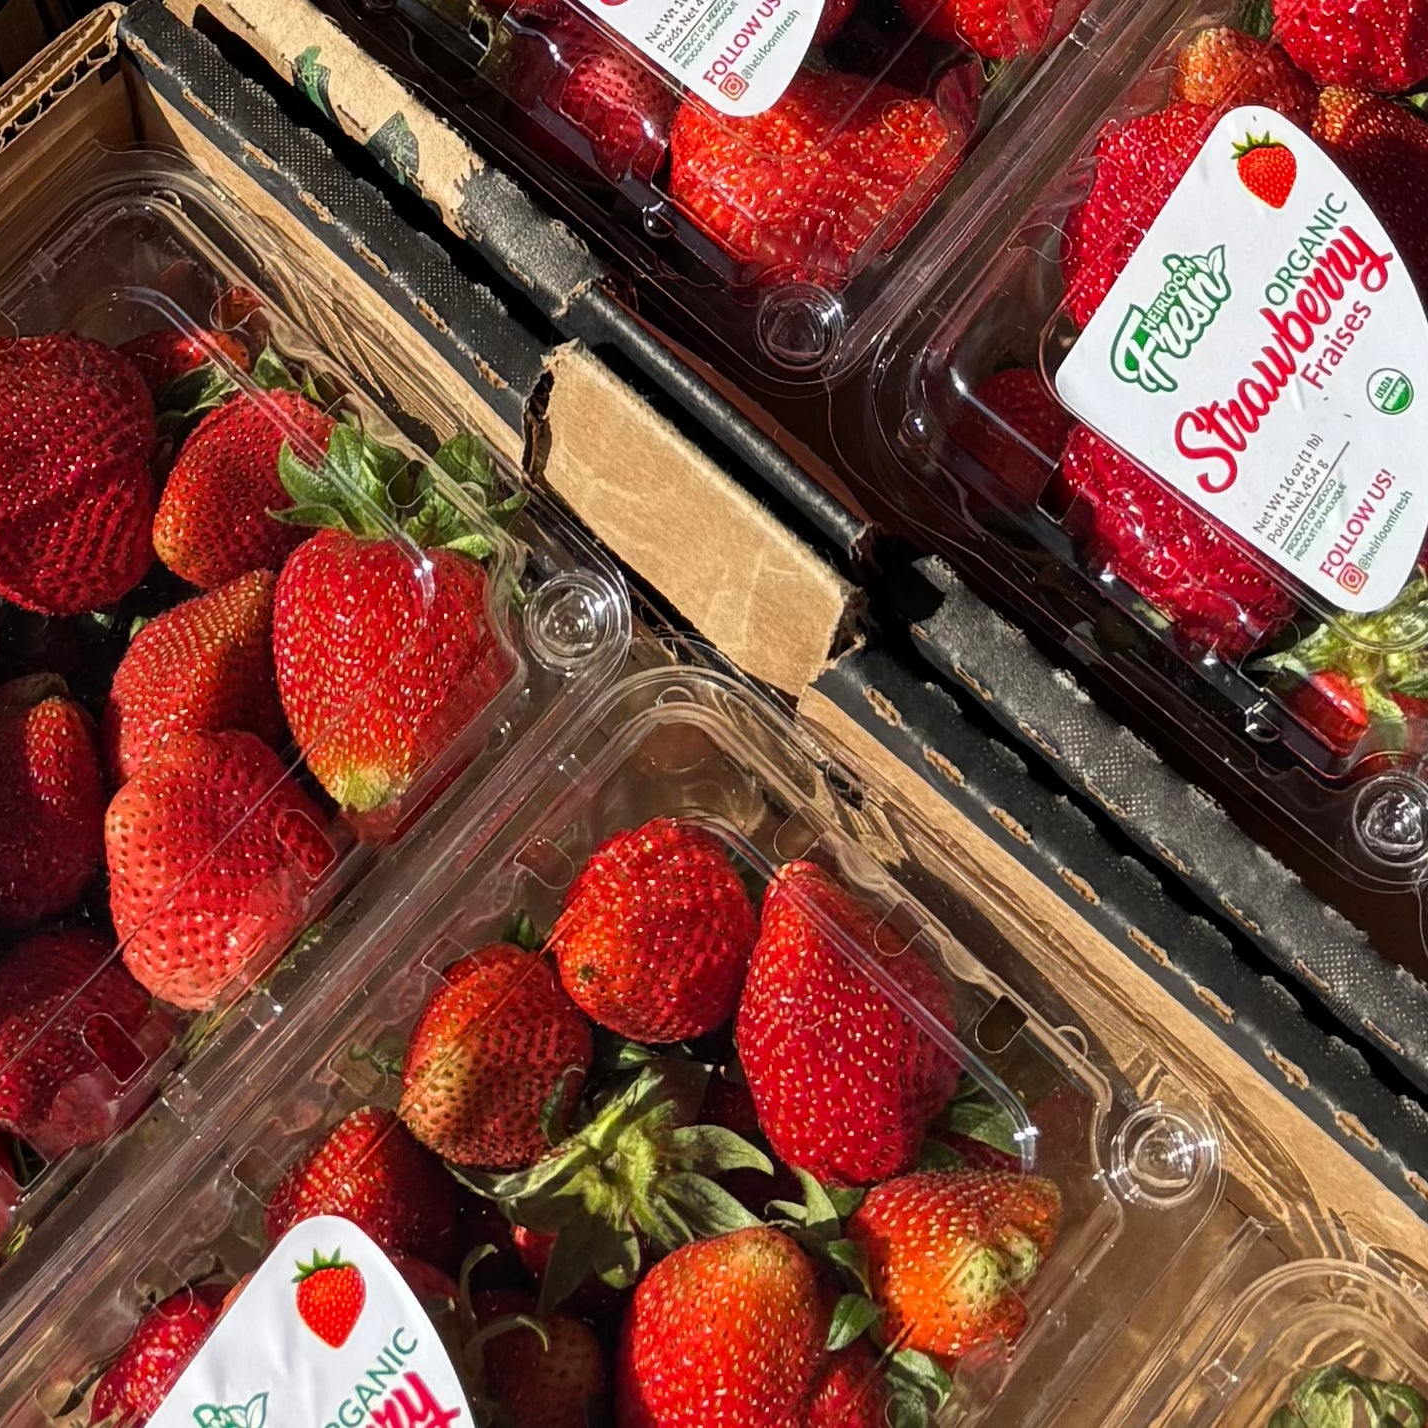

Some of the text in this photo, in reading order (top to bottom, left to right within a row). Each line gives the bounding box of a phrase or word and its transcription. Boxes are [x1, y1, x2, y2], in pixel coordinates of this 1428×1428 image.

[702, 14, 763, 86] FOLLOW
[1265, 192, 1347, 305] ORGANIC
[1110, 253, 1232, 394] Fresh
[1174, 227, 1392, 494] Strawberry
[1300, 301, 1371, 391] Fraises
[1318, 467, 1396, 579] FOLLOW US!
